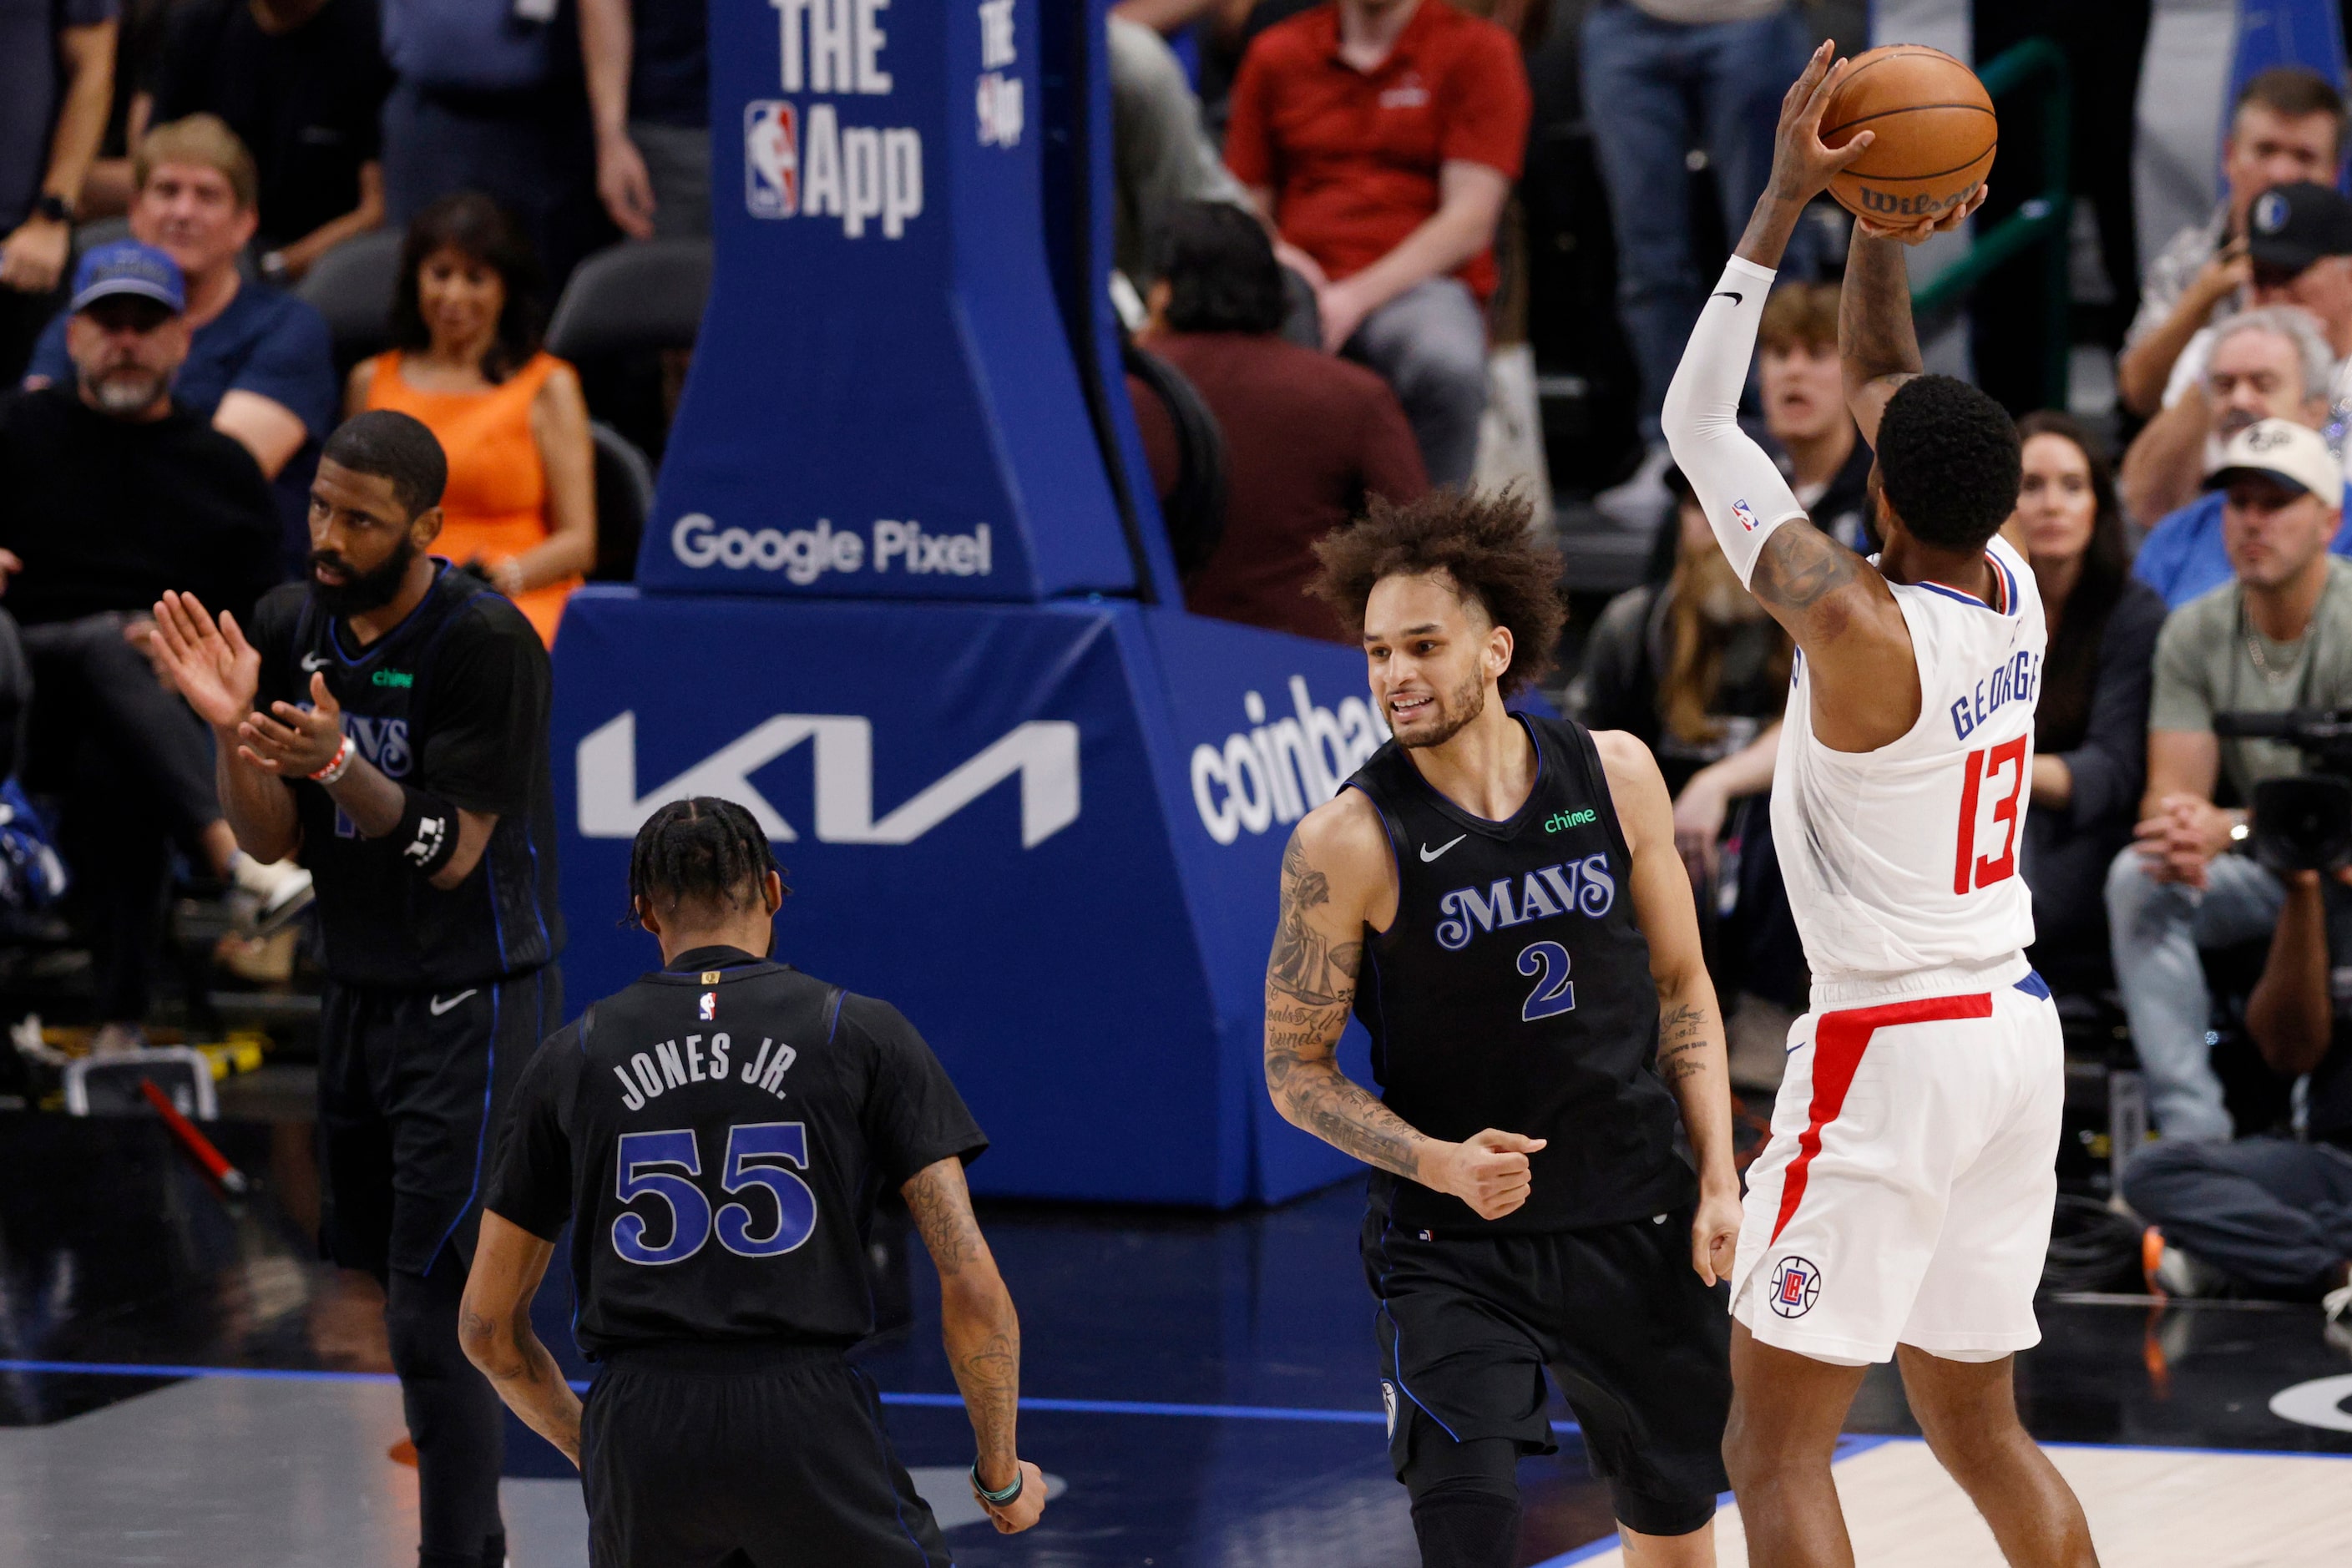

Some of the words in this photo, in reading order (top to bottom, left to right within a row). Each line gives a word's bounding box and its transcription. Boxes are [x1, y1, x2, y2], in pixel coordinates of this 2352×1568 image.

[769, 0, 893, 94] THE
[802, 103, 923, 239] App
[1859, 180, 1980, 216] Wilson
[671, 512, 864, 585] Google
[873, 518, 993, 577] Pixel
[1950, 650, 2039, 741] GEORGE
[576, 709, 1080, 850] KIA
[1545, 808, 1596, 833] chime
[1954, 733, 2027, 895] 13
[1435, 852, 1615, 951] MAVS
[1516, 941, 1576, 1022] 2
[613, 1032, 731, 1111] JONES
[741, 1037, 797, 1100] JR.
[611, 1122, 817, 1266] 55
